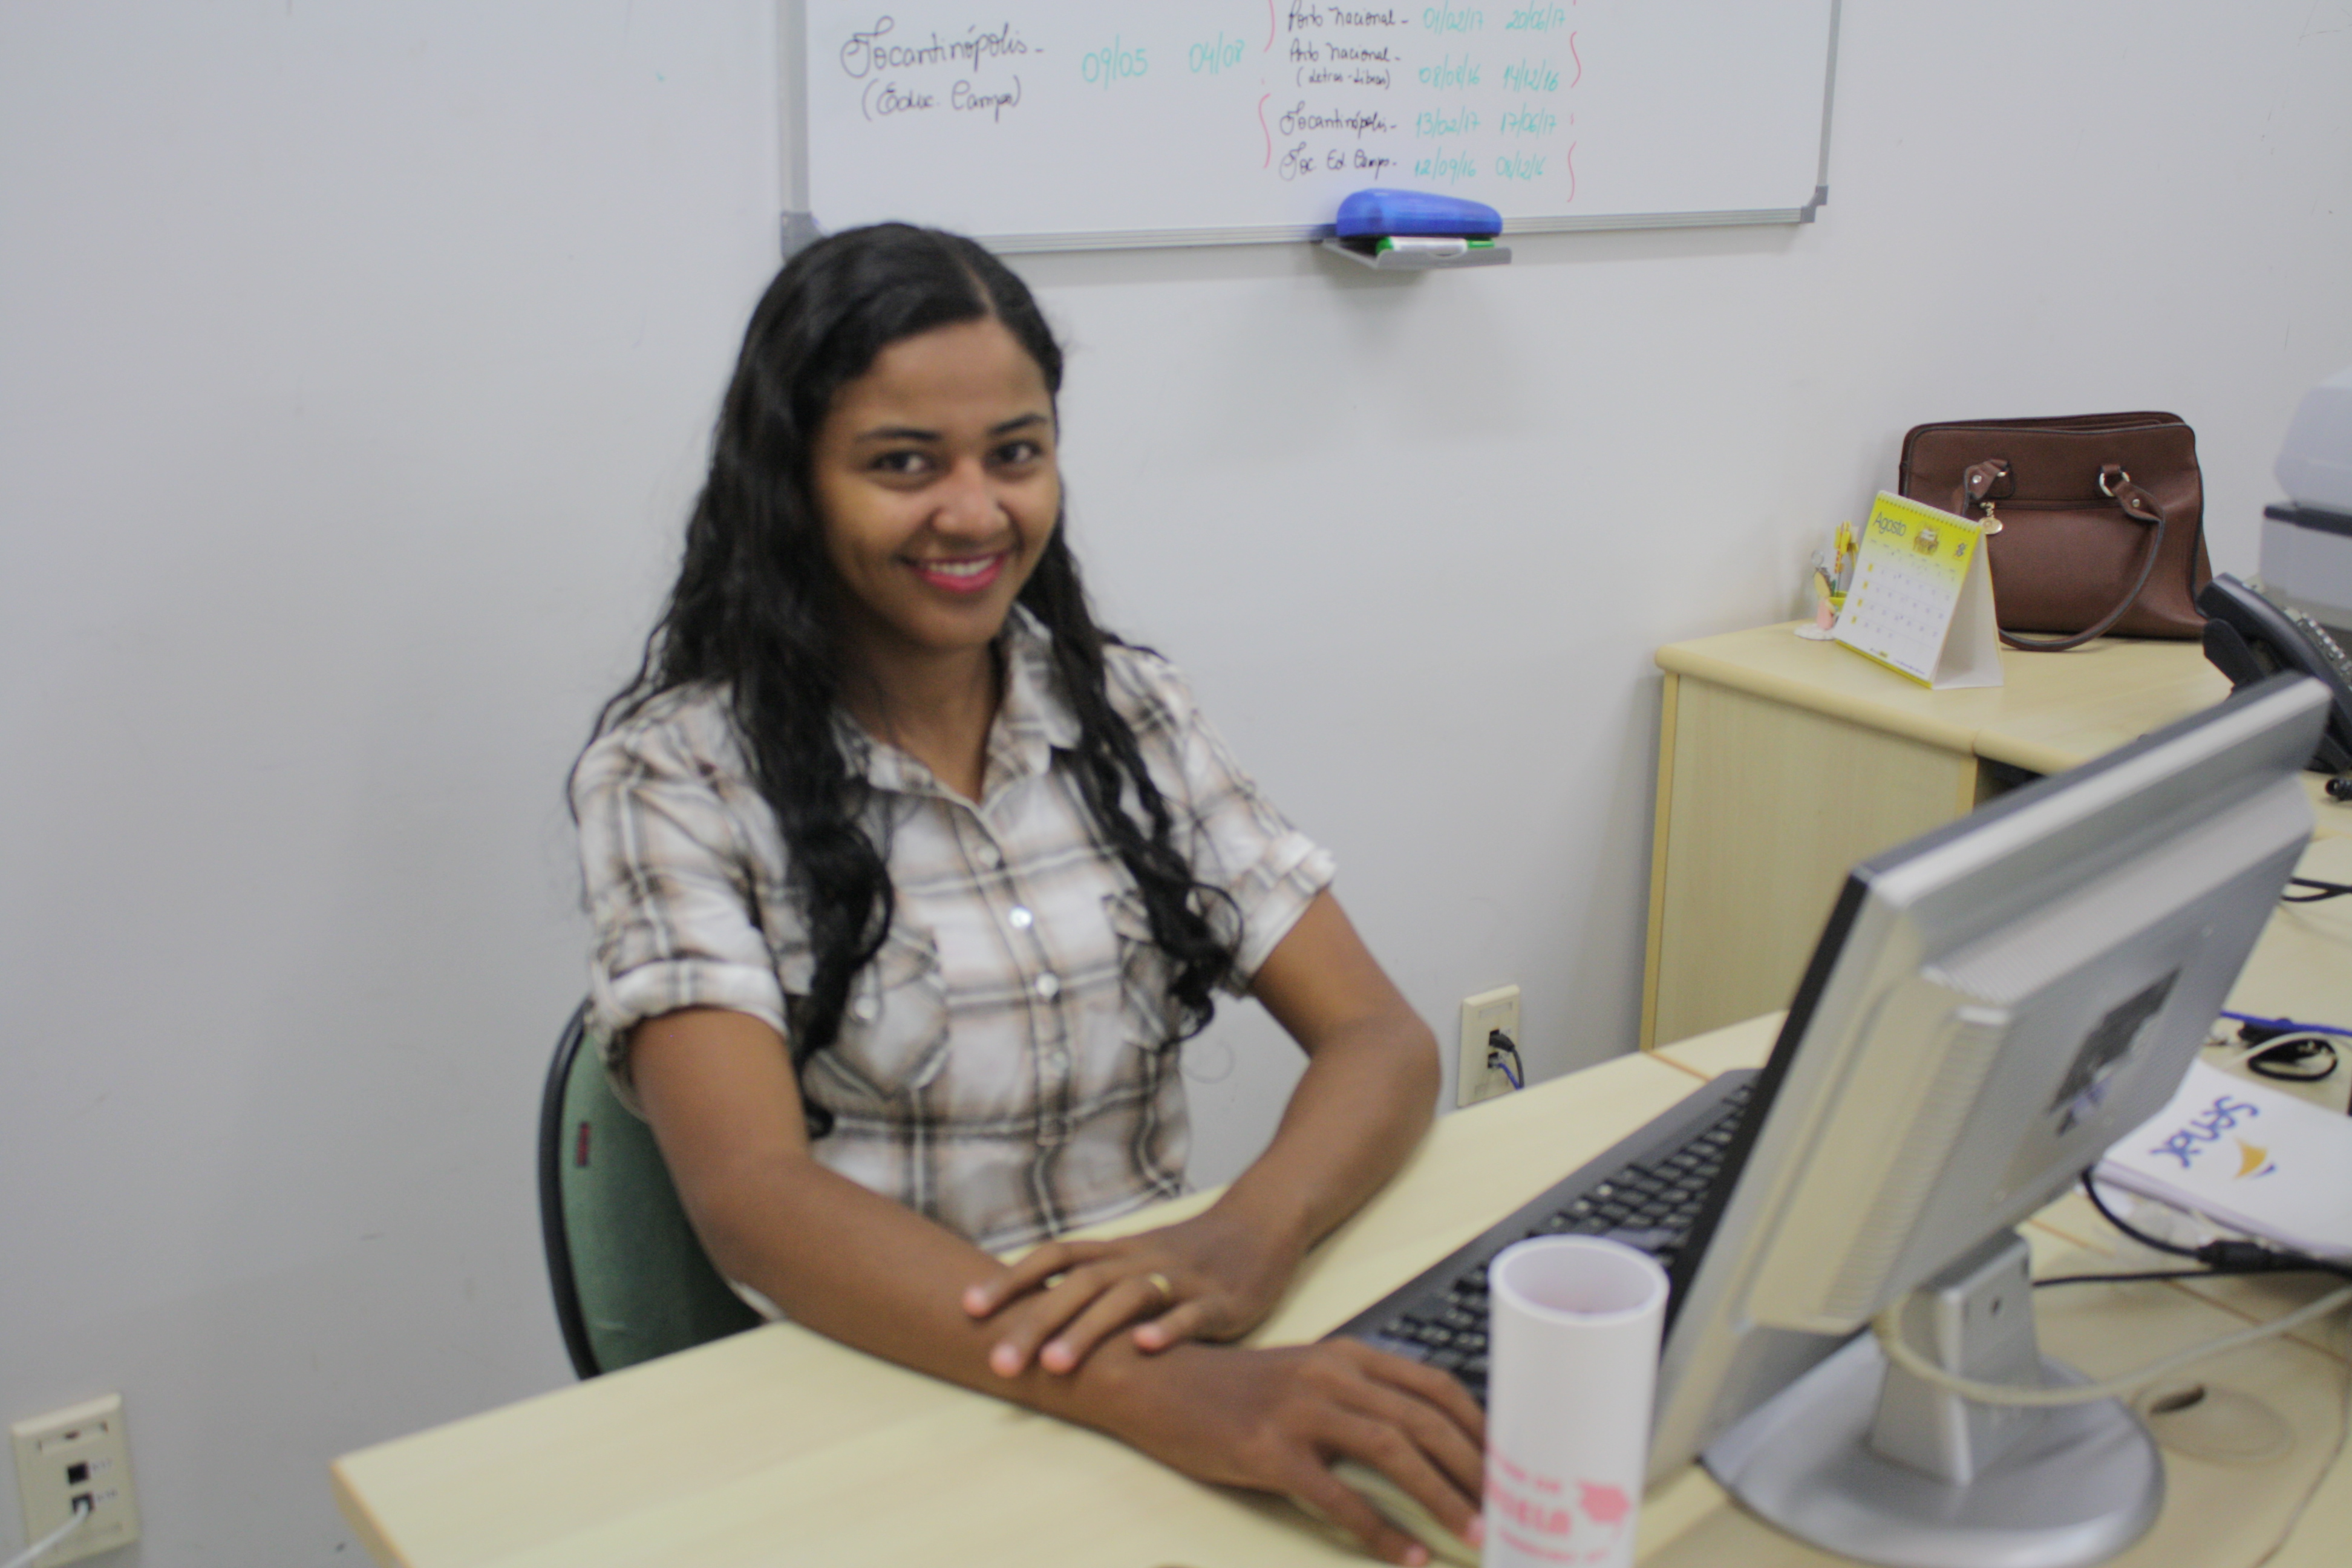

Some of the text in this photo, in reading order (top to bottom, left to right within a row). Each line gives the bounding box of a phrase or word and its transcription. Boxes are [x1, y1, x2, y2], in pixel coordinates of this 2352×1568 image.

[1288, 0, 1323, 32] Porto
[1423, 0, 1484, 33] 01/02/17
[1505, 0, 1566, 31] 20/06/17
[1081, 35, 1148, 88] 09/05
[1415, 105, 1480, 138] 13/02/17
[1414, 146, 1477, 185] 12/09/16
[1875, 512, 1907, 537] Agosto
